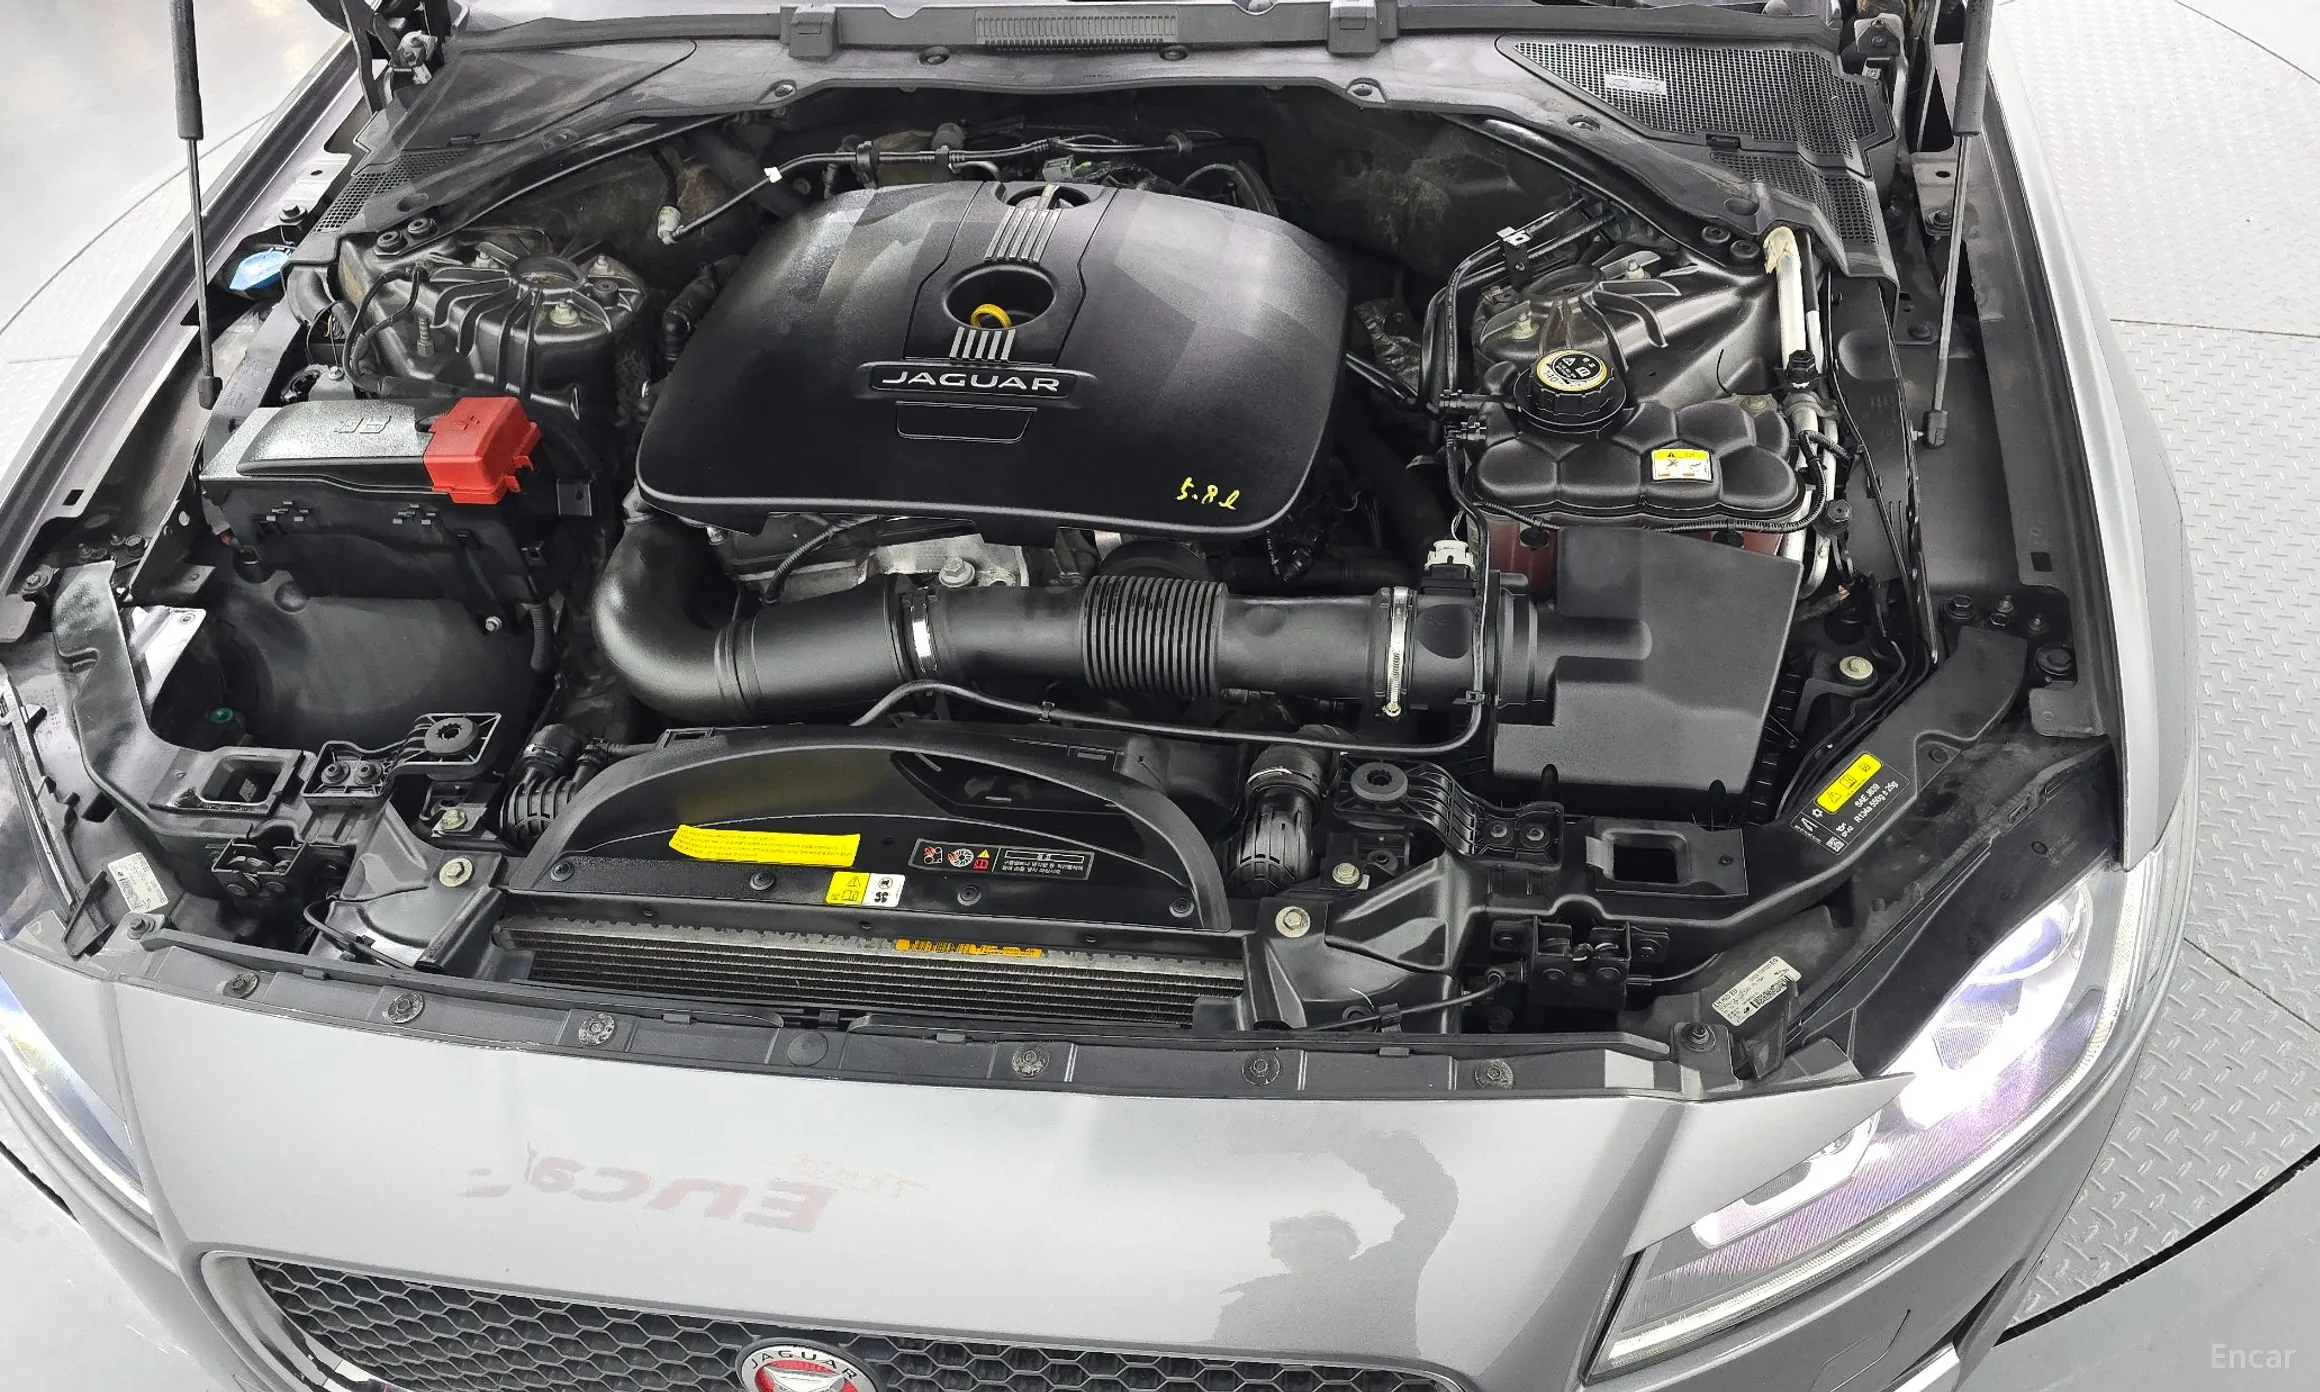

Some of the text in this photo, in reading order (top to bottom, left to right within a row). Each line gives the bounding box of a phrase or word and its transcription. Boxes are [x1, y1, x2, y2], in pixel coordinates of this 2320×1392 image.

[882, 371, 1060, 392] JAGUAR
[1854, 793, 1869, 808] SAE
[1853, 804, 1873, 823] R134a
[751, 1349, 858, 1378] JAGUAR
